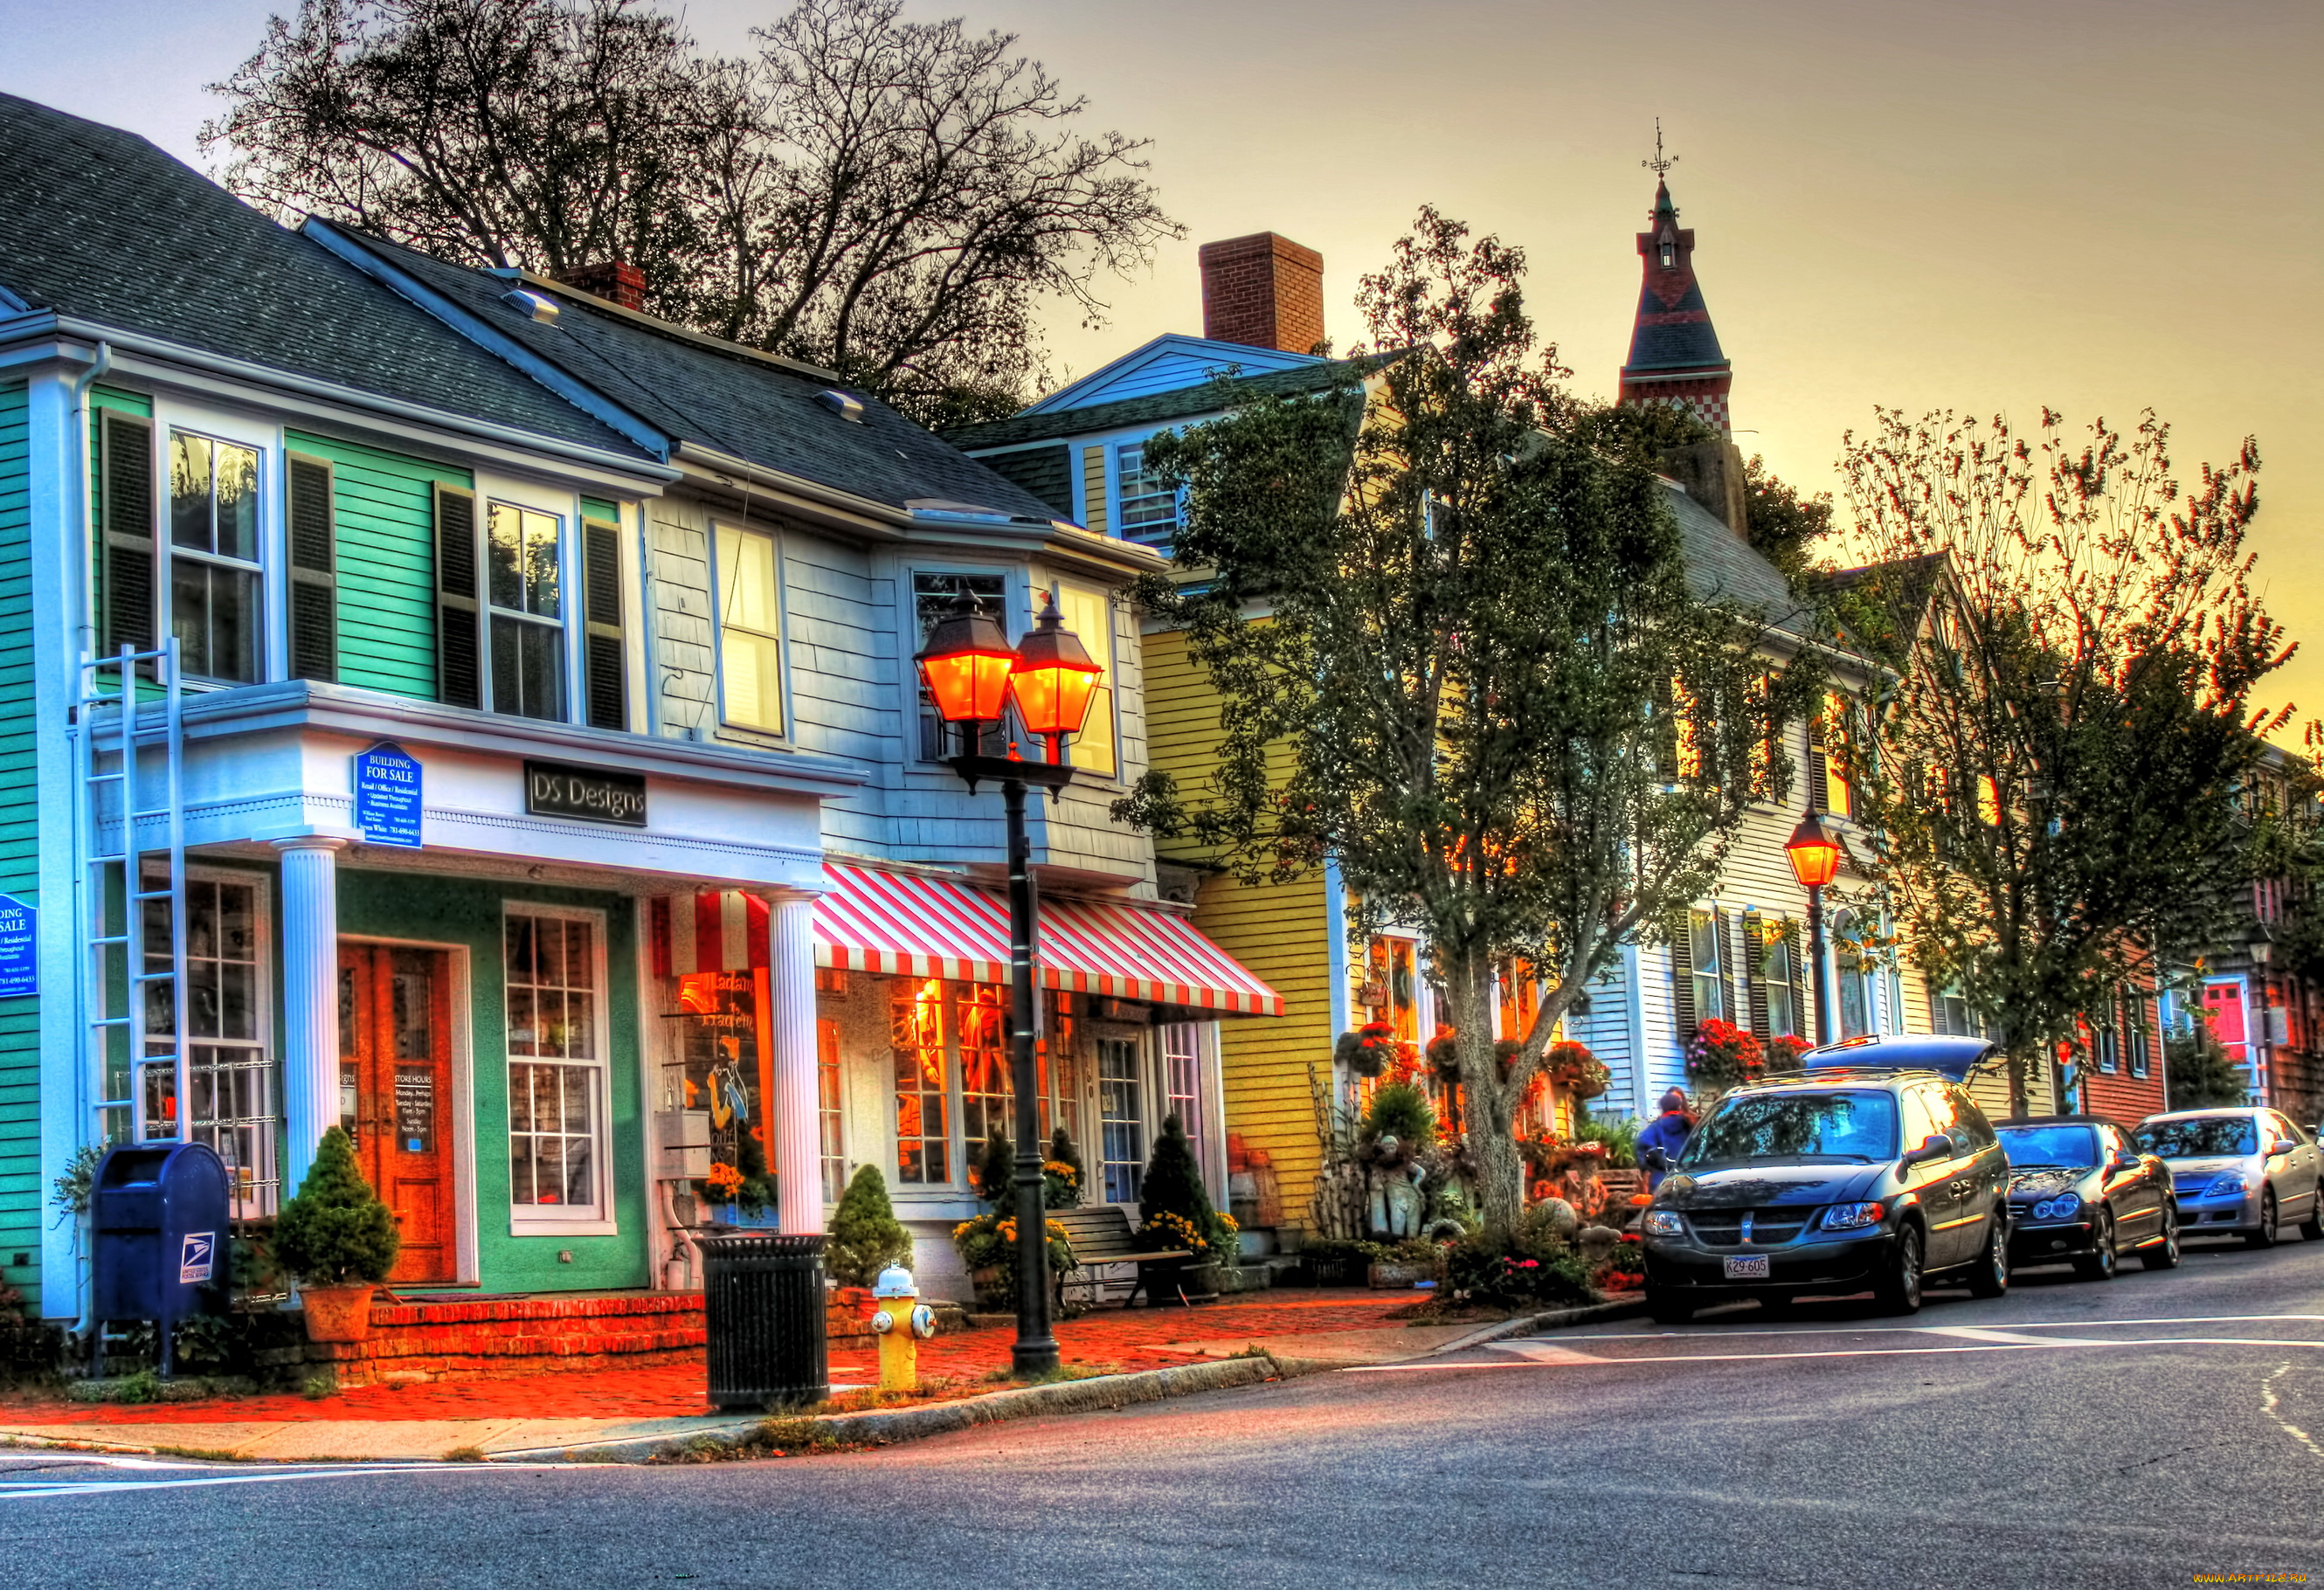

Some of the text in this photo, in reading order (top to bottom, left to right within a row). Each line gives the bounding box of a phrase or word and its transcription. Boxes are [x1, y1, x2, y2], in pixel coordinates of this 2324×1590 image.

[370, 755, 411, 769] BUILDING
[366, 765, 413, 783] FOR SALE
[361, 781, 374, 791] Retail
[377, 784, 391, 793] Office
[395, 785, 418, 796] Residential
[389, 794, 412, 804] Throughout
[534, 774, 644, 818] DS Designs
[370, 799, 390, 808] Business
[373, 824, 387, 833] White
[0, 918, 27, 933] SALE
[4, 934, 31, 944] Residential
[395, 1075, 432, 1083] STORE HOURS
